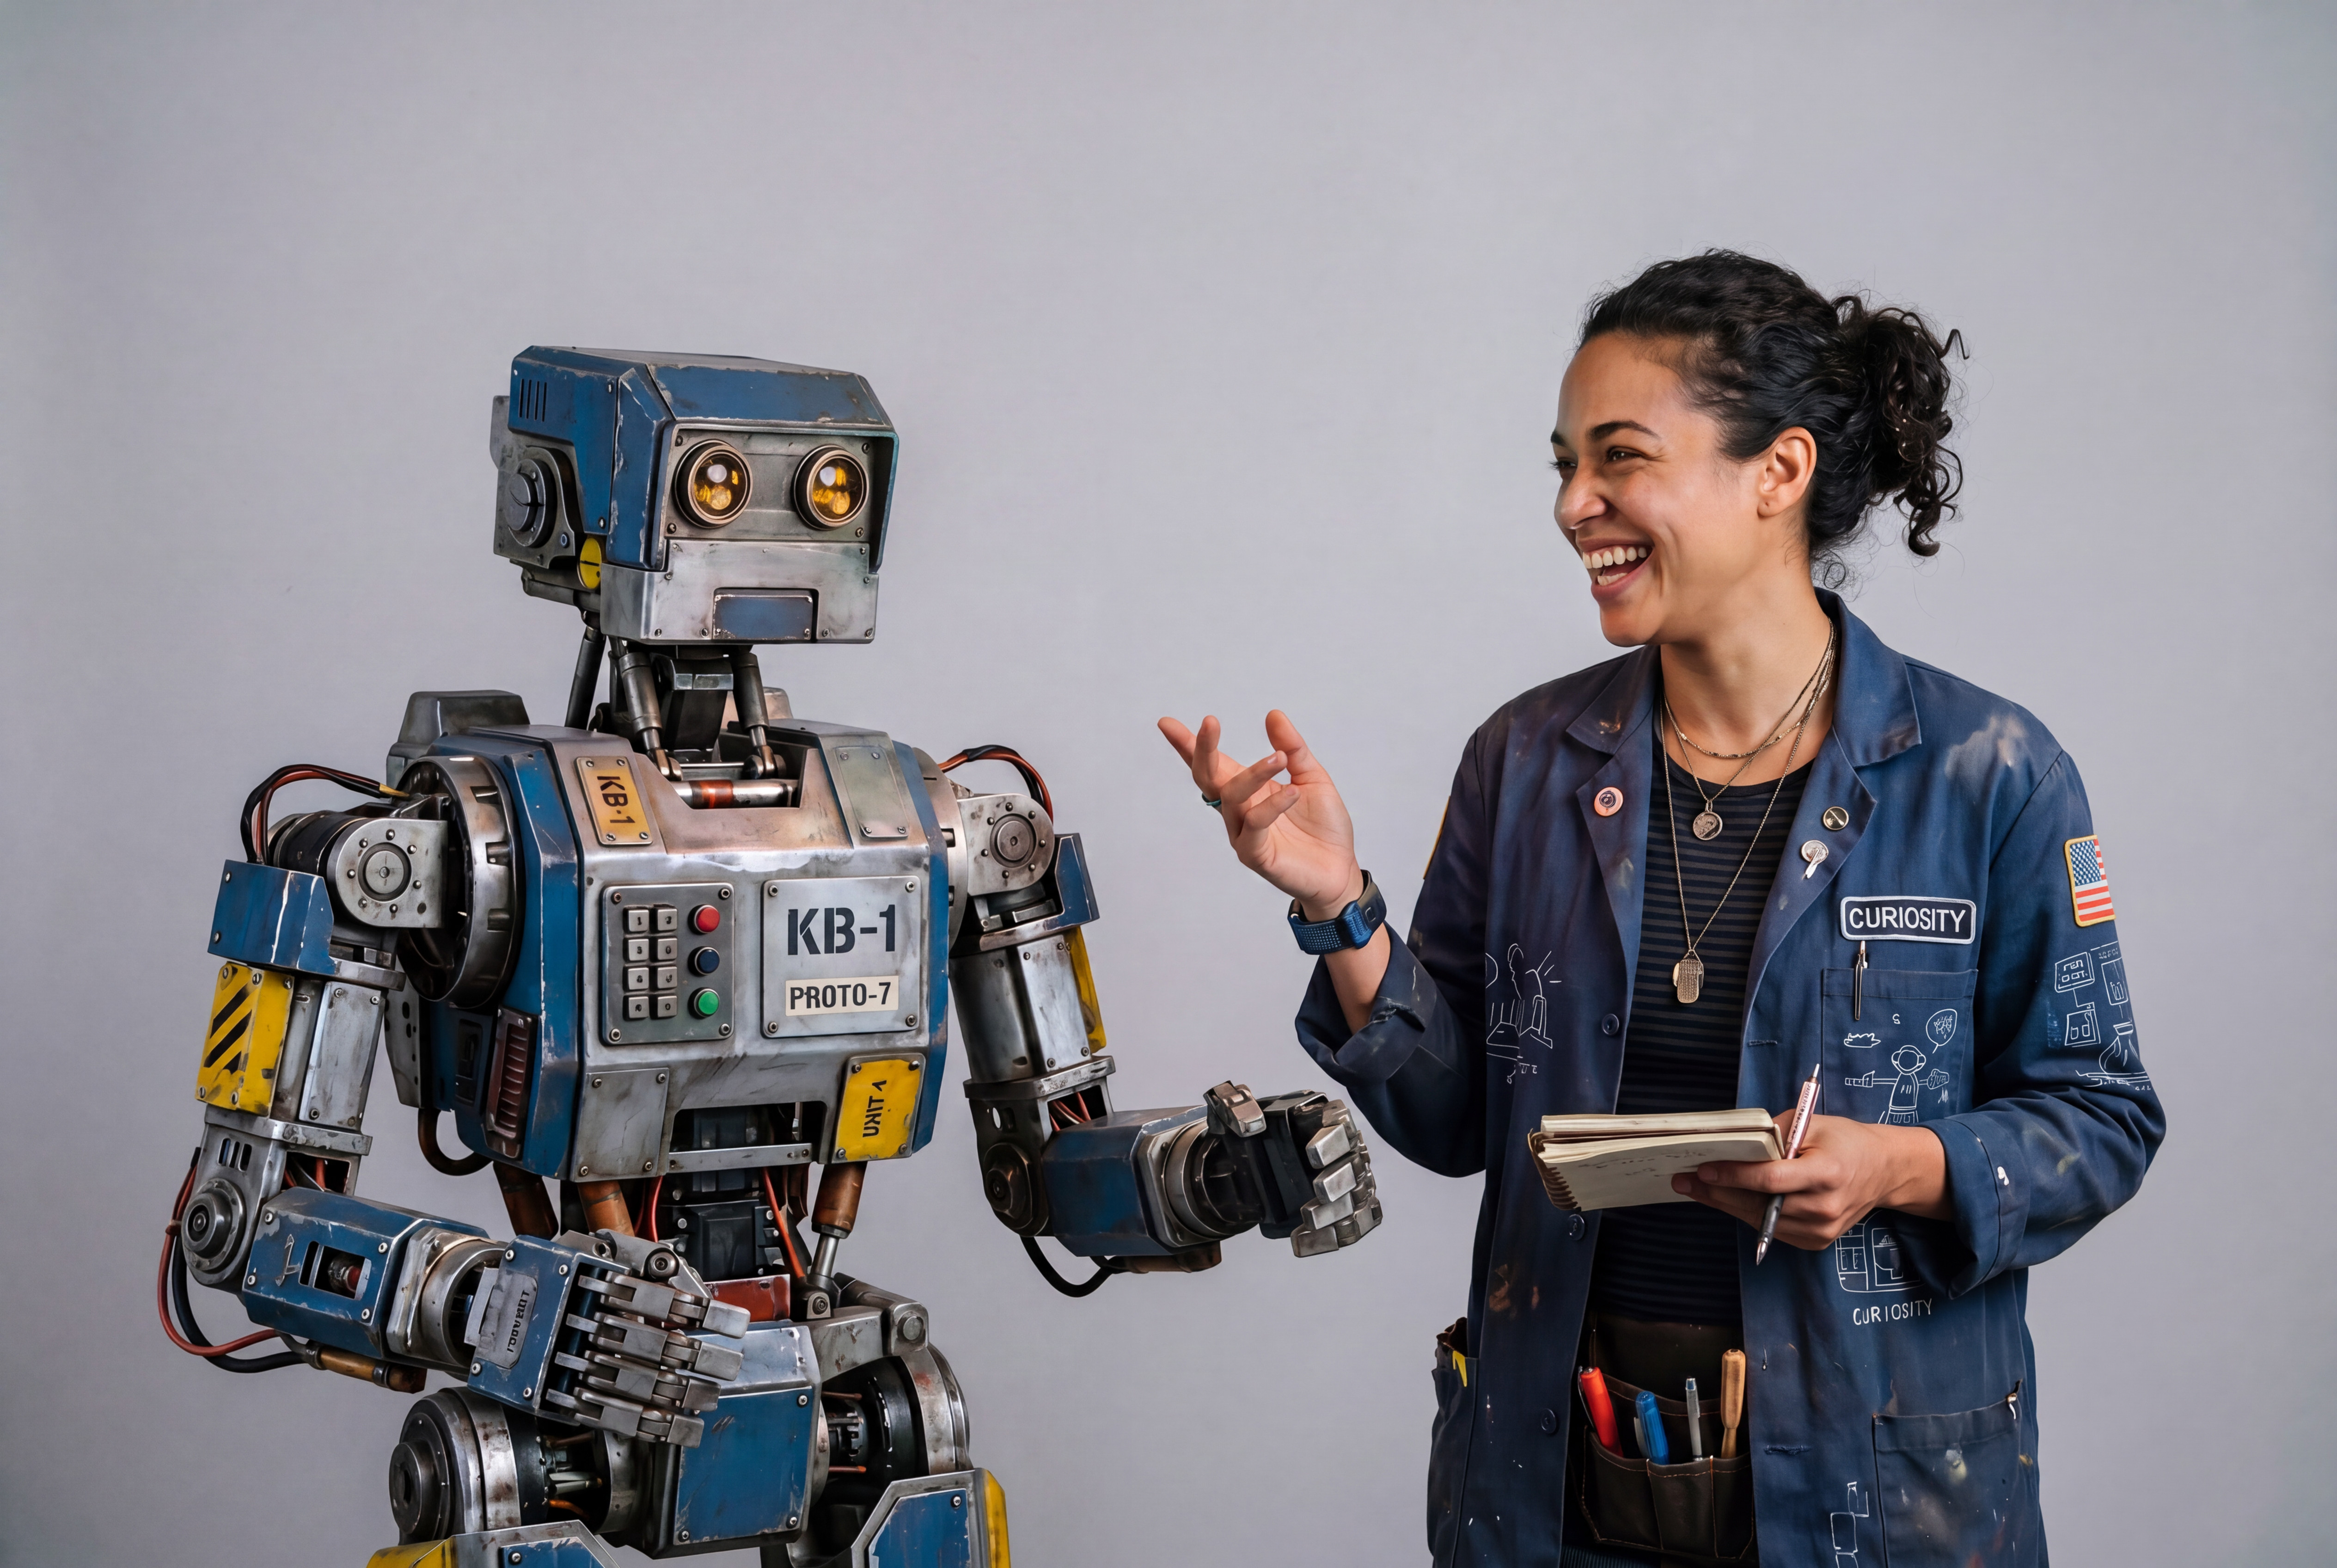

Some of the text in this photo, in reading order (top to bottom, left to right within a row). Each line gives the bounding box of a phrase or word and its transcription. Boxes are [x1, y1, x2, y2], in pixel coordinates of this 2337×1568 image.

[788, 904, 895, 956] KB-1
[1849, 906, 1966, 932] CURIOSITY
[790, 982, 891, 1010] PROTO-7
[1853, 1298, 1932, 1325] CURIOSITY
